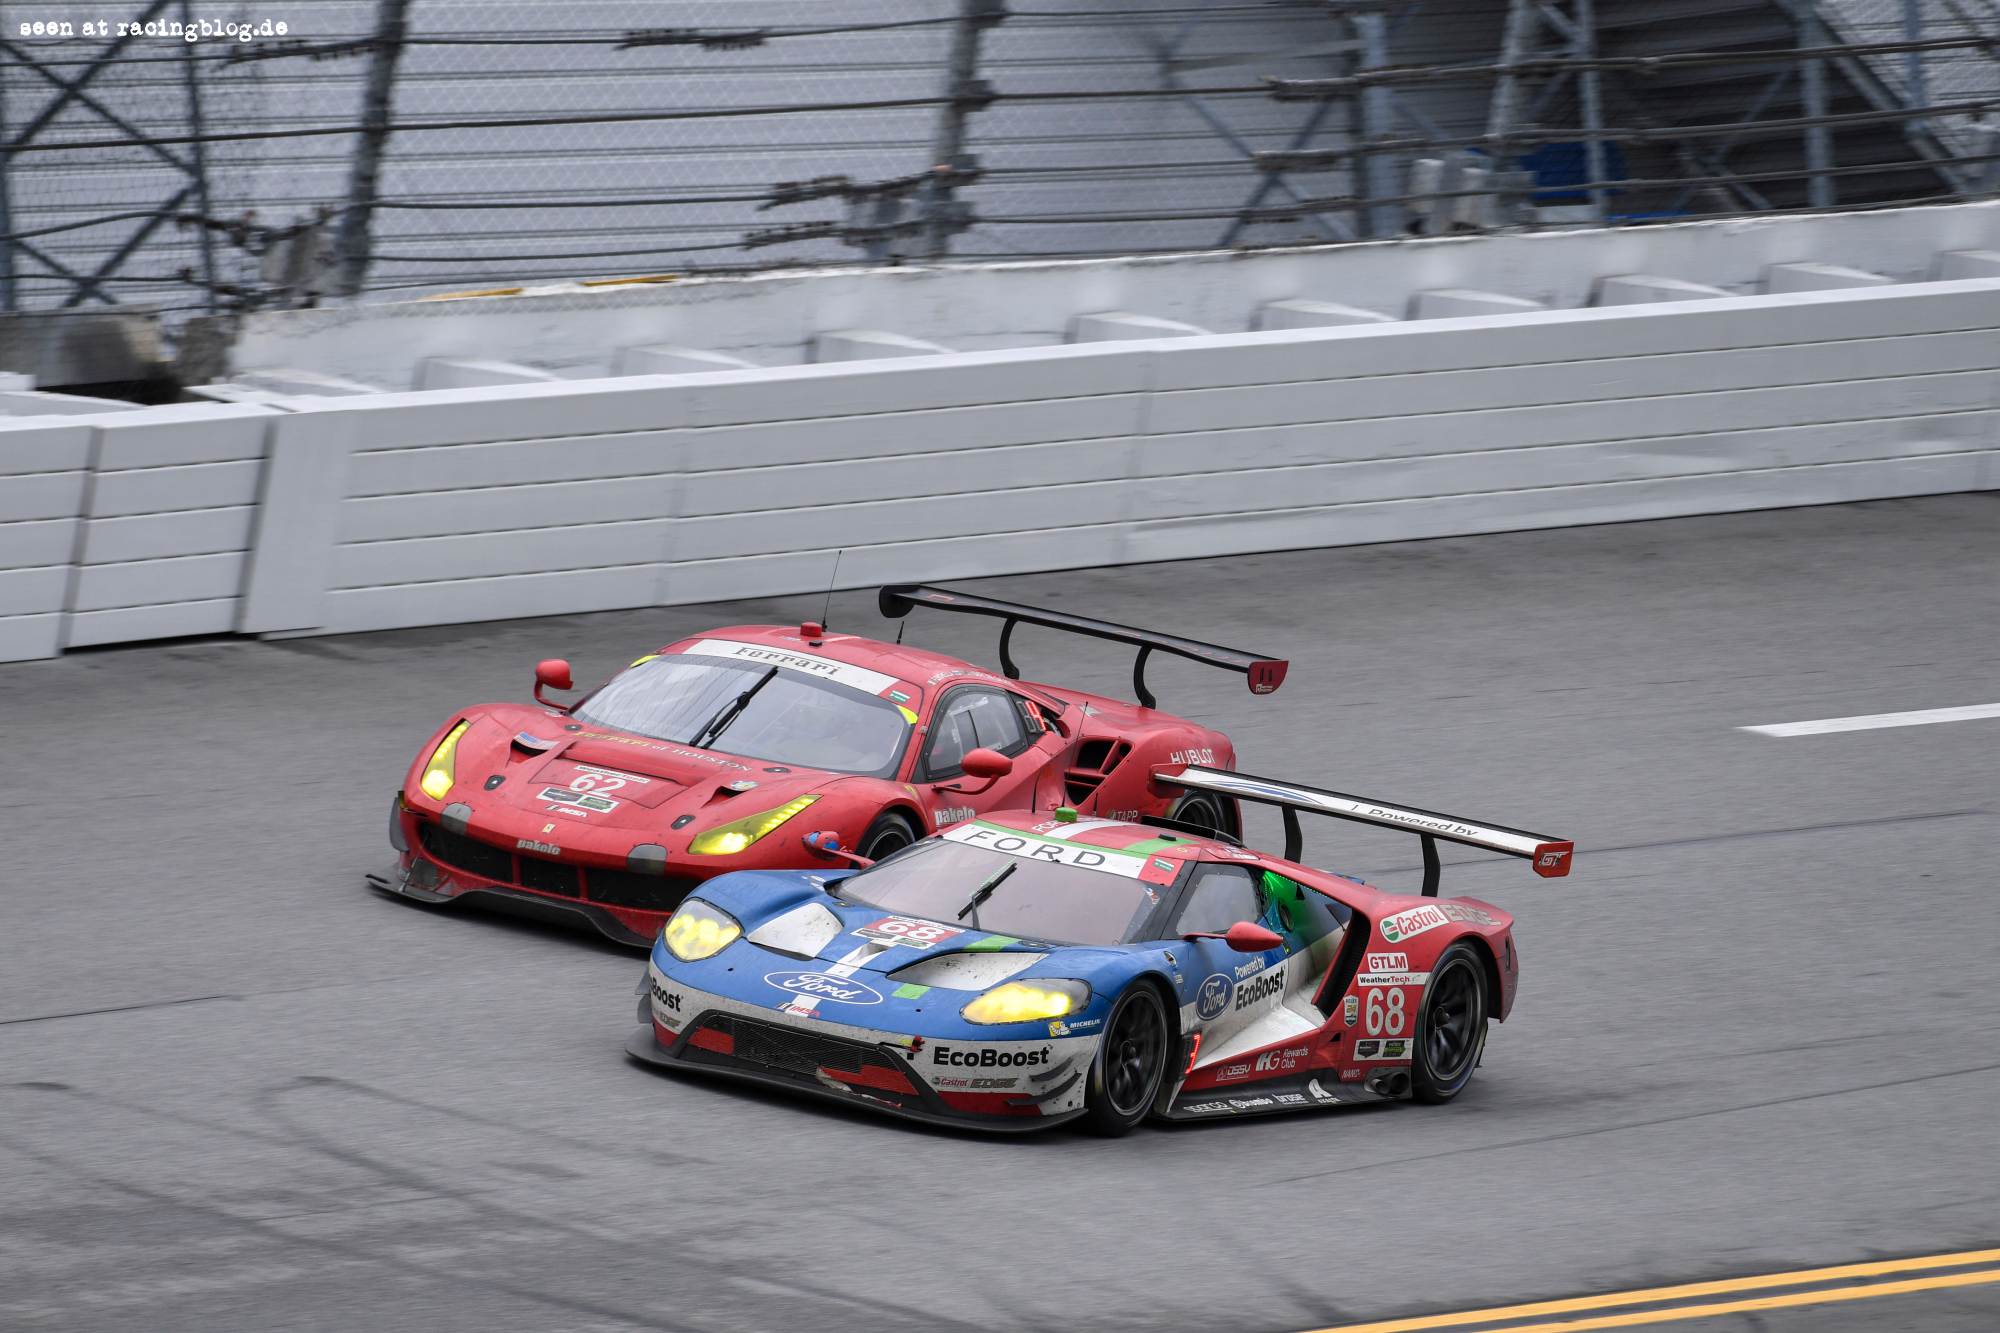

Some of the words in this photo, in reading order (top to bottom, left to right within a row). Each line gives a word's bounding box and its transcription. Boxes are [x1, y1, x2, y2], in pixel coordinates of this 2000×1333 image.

[733, 646, 842, 676] Ferrari
[1170, 748, 1216, 765] HUBLOT
[569, 773, 627, 798] 62
[934, 808, 976, 827] pakelo
[1367, 808, 1451, 832] Powered
[1453, 825, 1479, 836] by
[516, 837, 561, 856] pakelo
[964, 830, 1106, 867] FORD
[877, 920, 946, 940] 68
[1398, 908, 1444, 936] Castrol
[1234, 961, 1258, 980] Powered
[1257, 956, 1266, 972] by
[1369, 955, 1408, 970] GTLM
[783, 974, 863, 1000] Ford
[1235, 966, 1286, 1012] EcoBoost
[1359, 976, 1411, 986] WeatherTech
[1202, 980, 1227, 1014] Ford
[1365, 987, 1406, 1036] 68
[933, 1046, 1051, 1068] EcoBoost
[1255, 1050, 1280, 1073] IHG
[1281, 1058, 1296, 1069] Club
[1282, 1047, 1309, 1059] Rewards
[941, 1077, 969, 1087] Castrol
